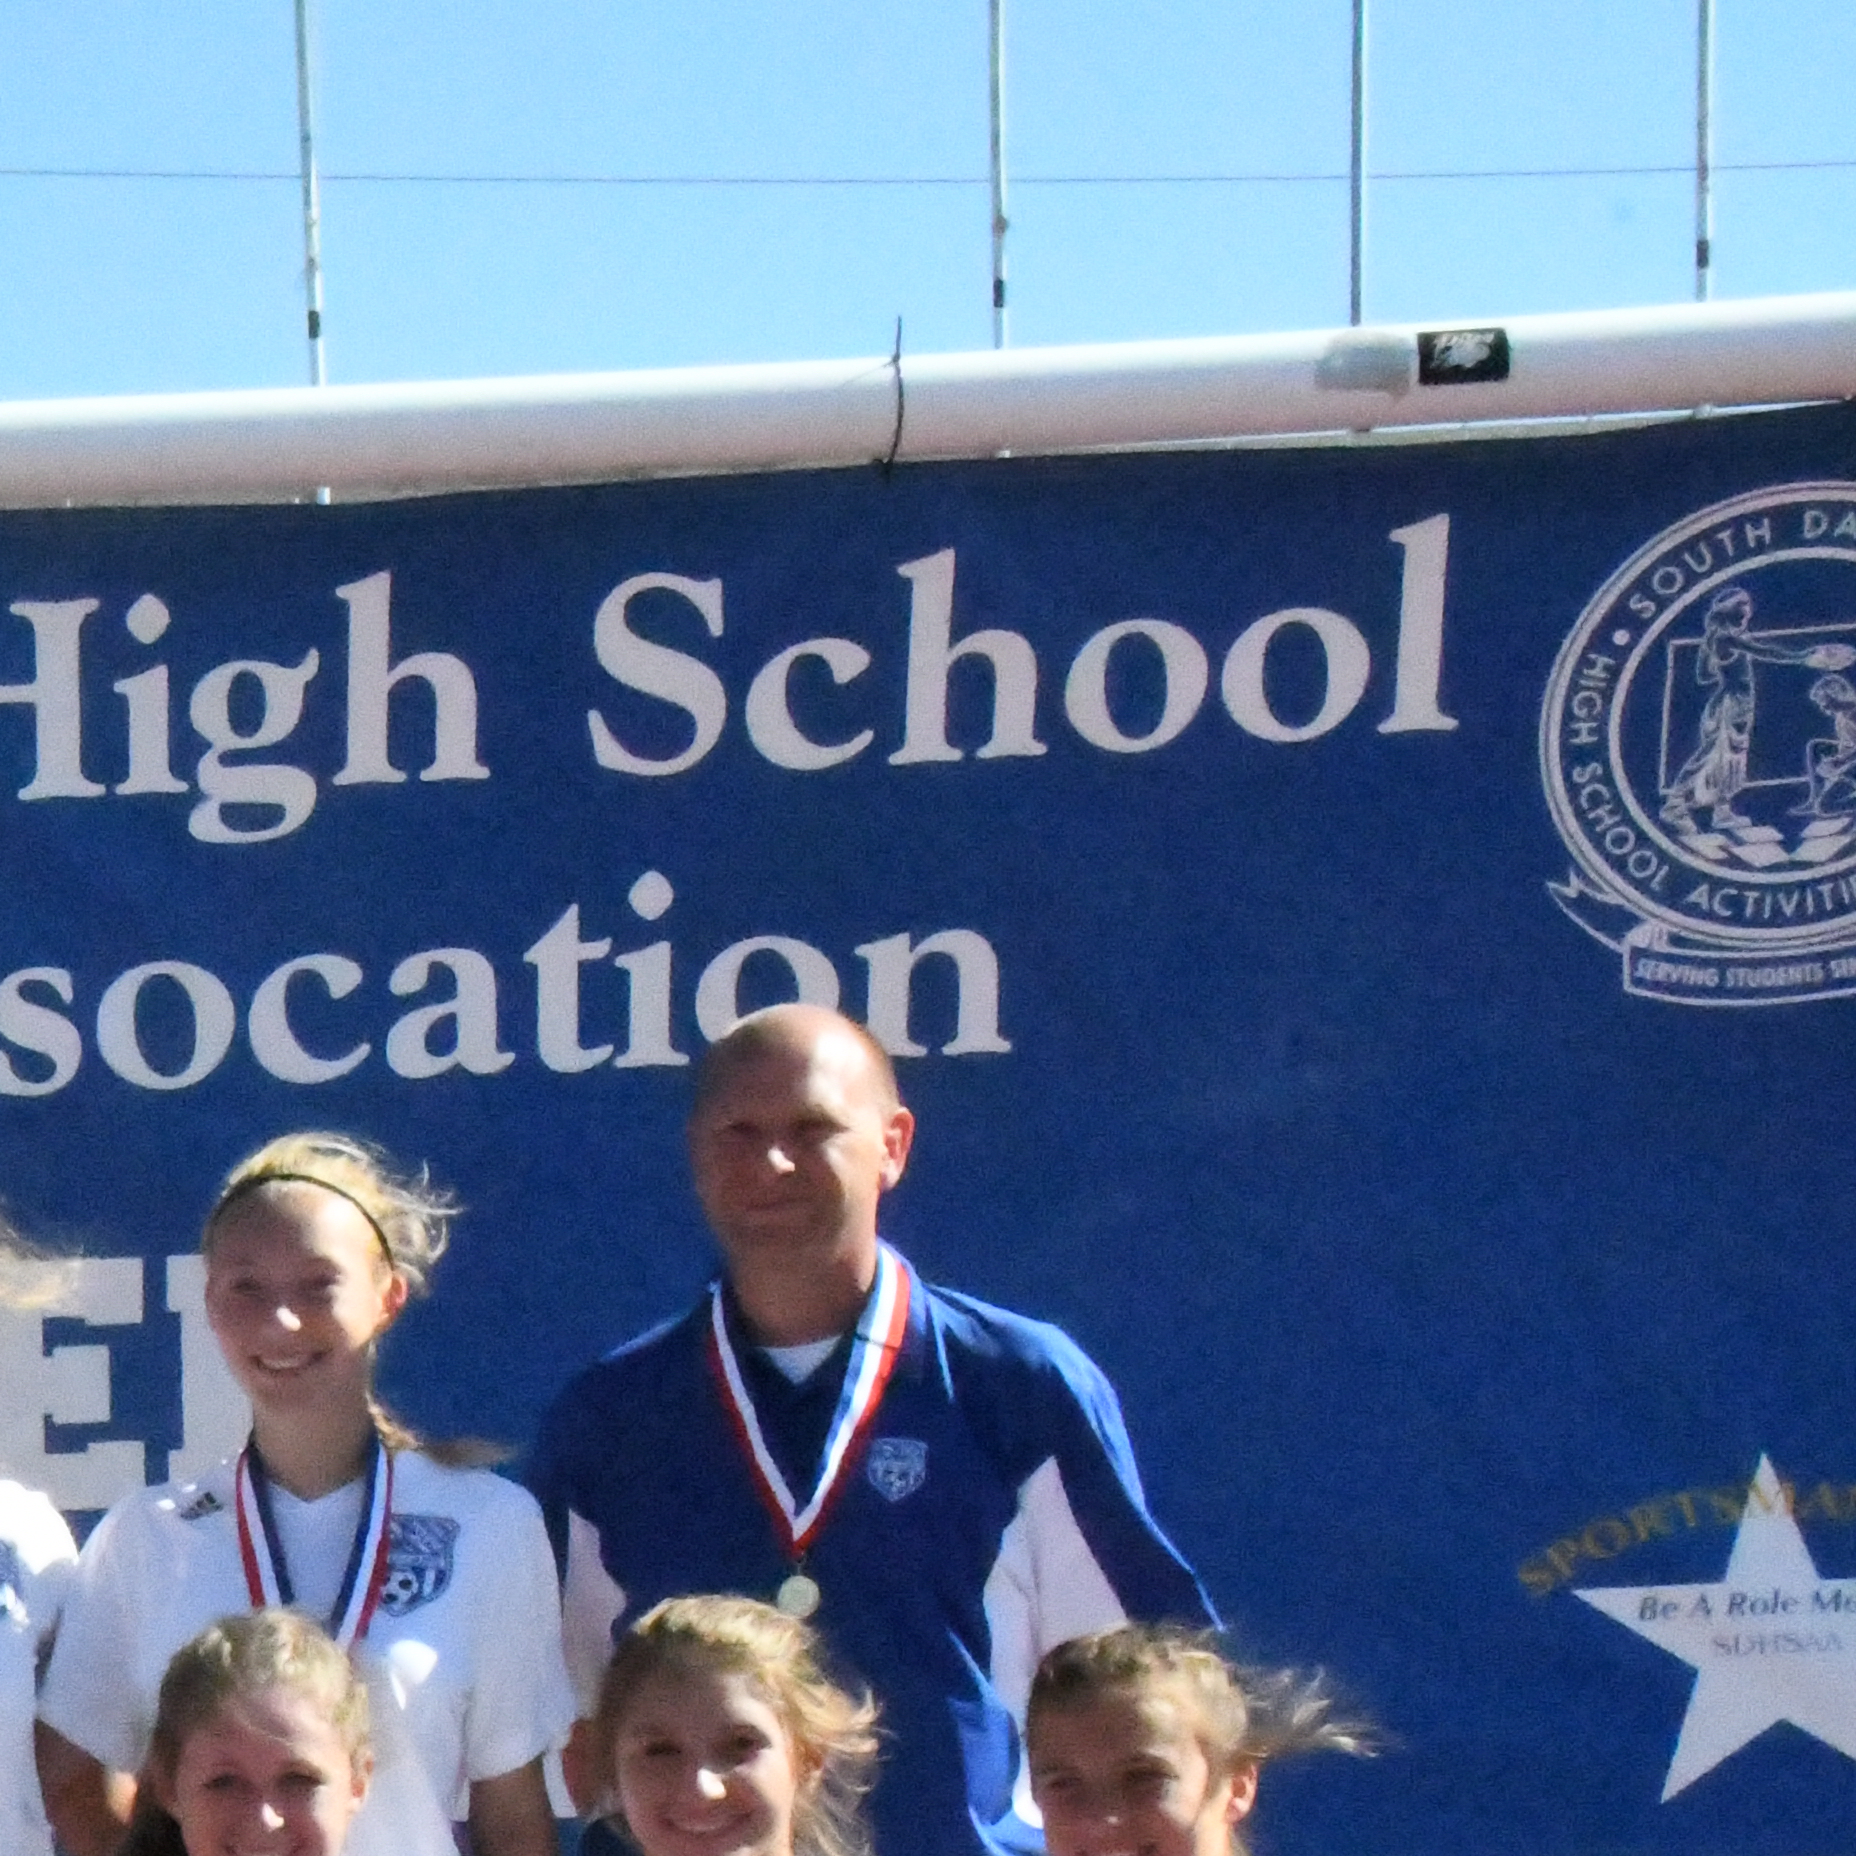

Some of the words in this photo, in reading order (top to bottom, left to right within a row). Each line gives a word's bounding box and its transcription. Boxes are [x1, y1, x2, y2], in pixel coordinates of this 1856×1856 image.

[1629, 512, 1772, 619] SOUTH
[588, 513, 1459, 776] School
[1569, 652, 1616, 747] HIGH
[1572, 761, 1671, 891] SCHOOL
[1639, 1596, 1679, 1621] Be
[1692, 1593, 1713, 1616] A
[1728, 1587, 1800, 1617] Role
